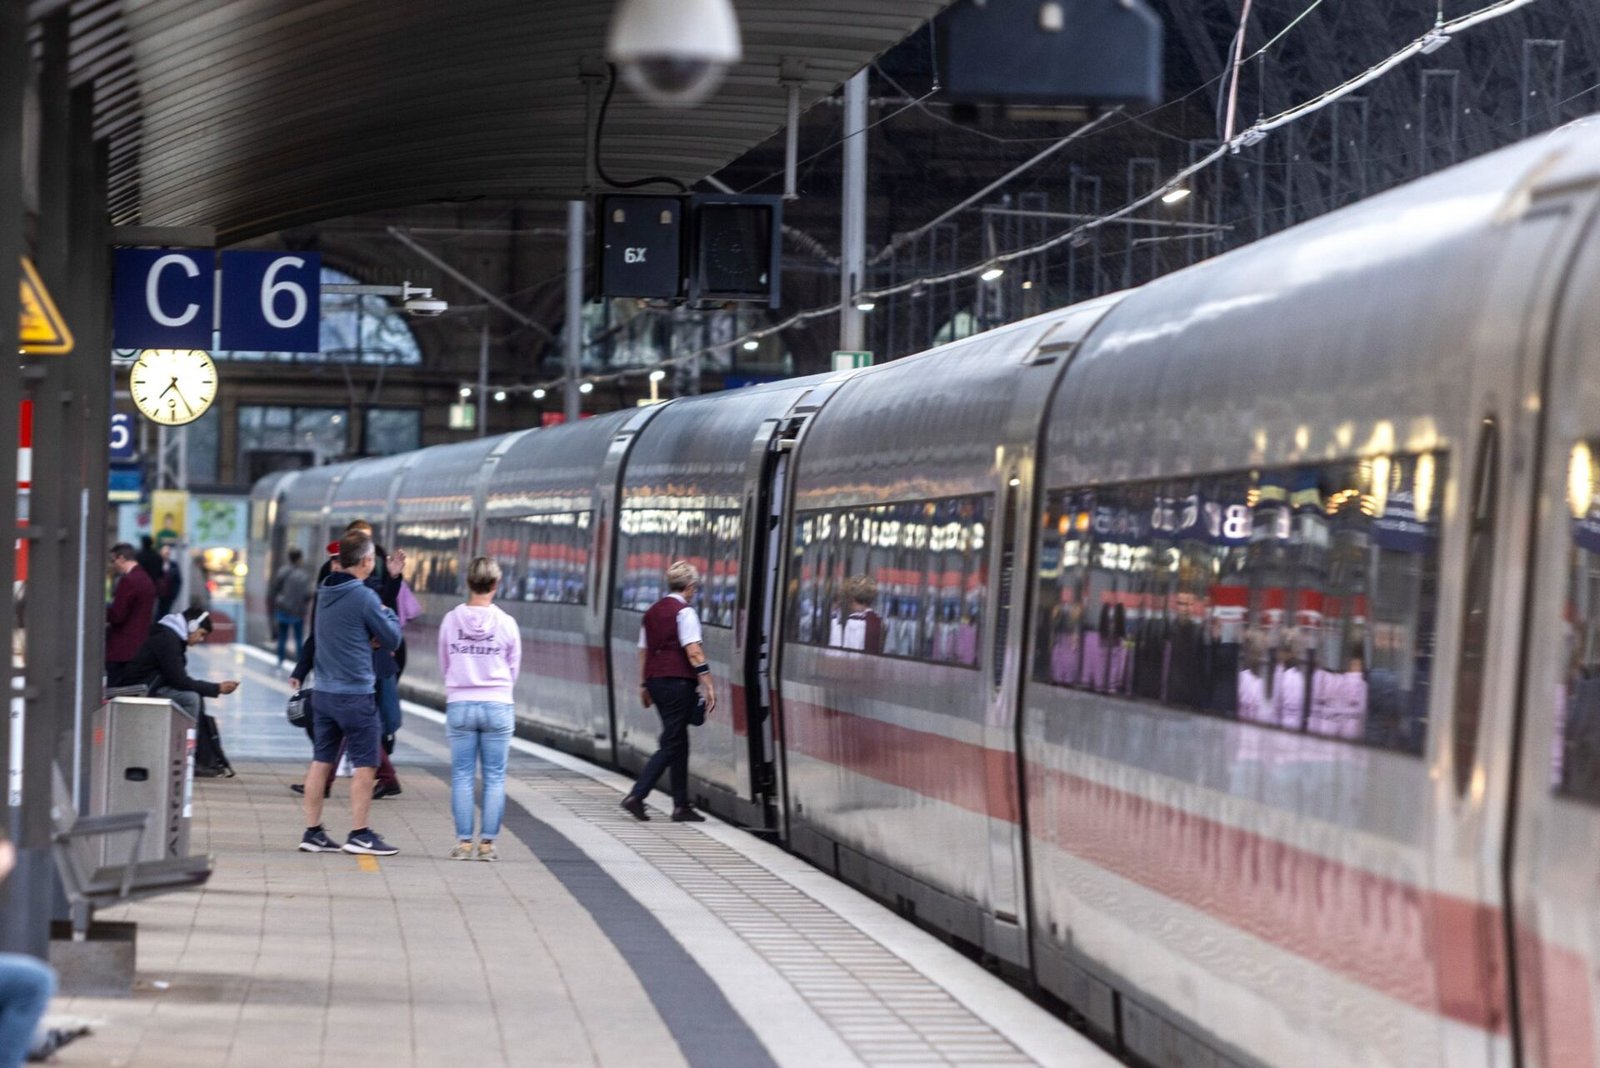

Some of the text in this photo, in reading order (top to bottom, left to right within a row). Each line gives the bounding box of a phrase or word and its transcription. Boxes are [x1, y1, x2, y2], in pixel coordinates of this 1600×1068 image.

[145, 254, 200, 327] C
[260, 255, 308, 328] 6
[449, 643, 501, 655] Nature
